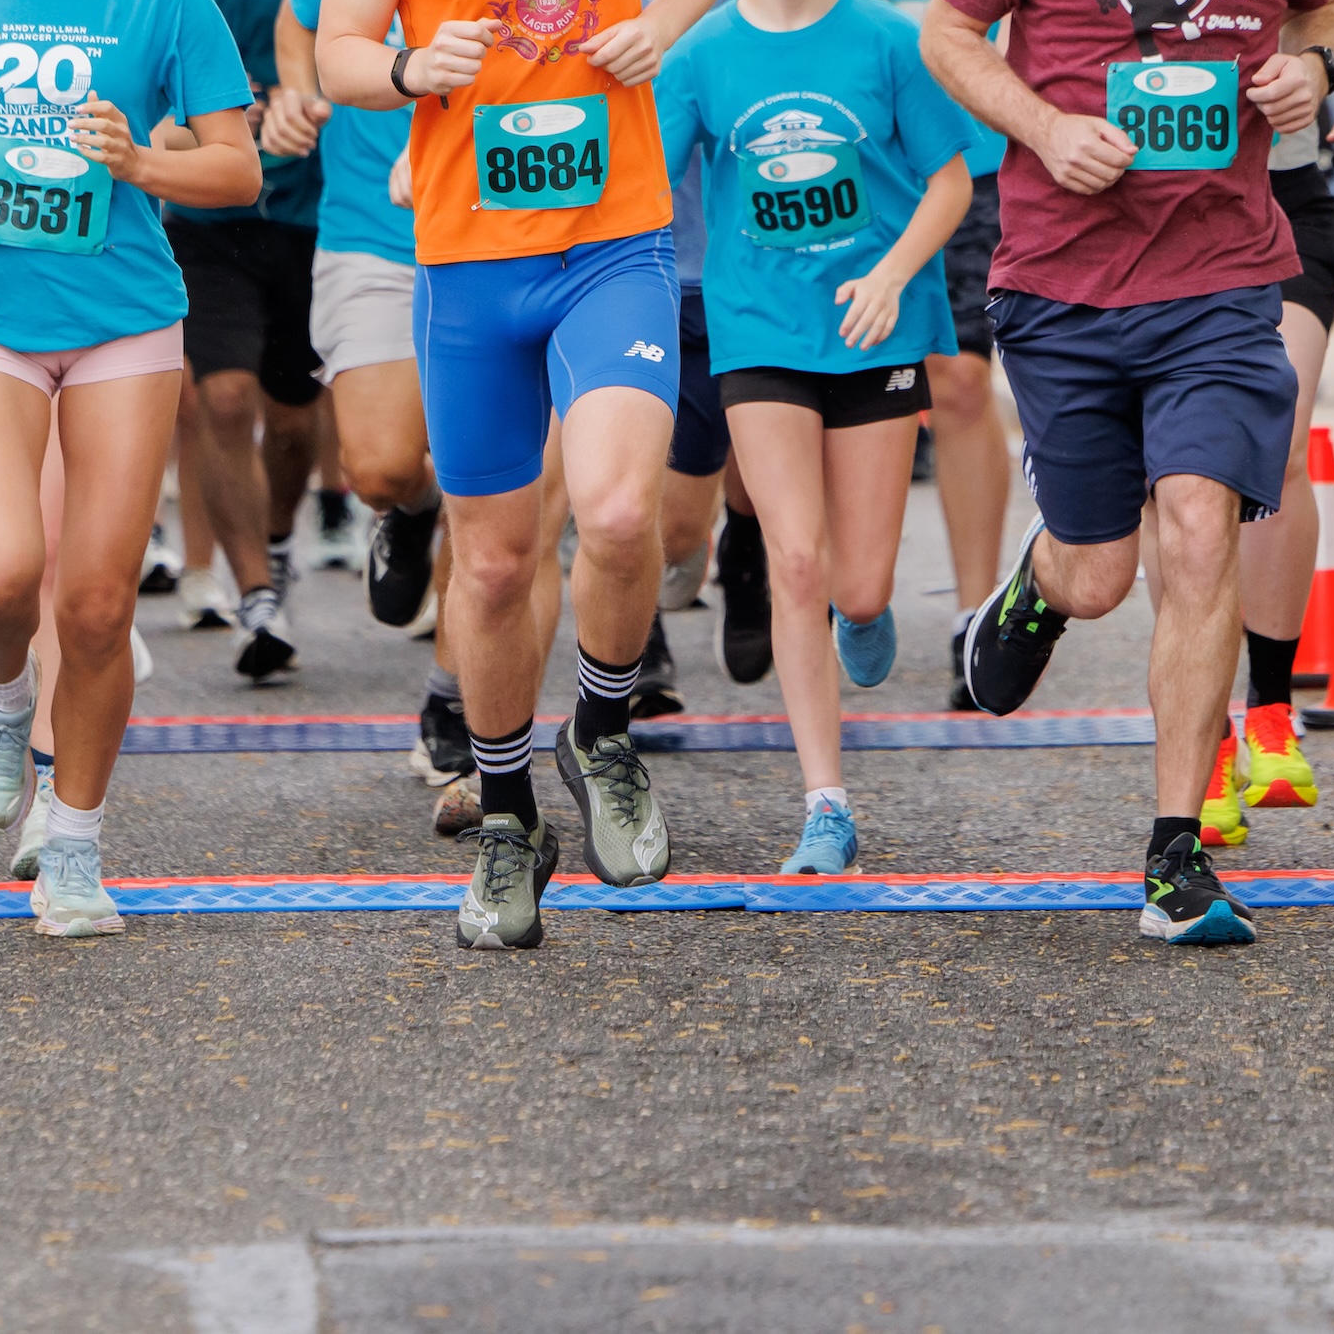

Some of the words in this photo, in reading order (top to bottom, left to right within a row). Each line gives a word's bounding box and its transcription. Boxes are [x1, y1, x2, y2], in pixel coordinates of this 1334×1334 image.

[2, 24, 36, 33] SANDY
[39, 25, 87, 34] ROLLMAN
[522, 14, 554, 32] LAGER
[556, 9, 575, 29] RUN
[1197, 16, 1204, 27] 1
[11, 33, 52, 42] CANCER
[55, 34, 118, 45] FOUNDATION
[1118, 104, 1229, 153] 8669
[486, 138, 603, 193] 8684
[752, 178, 858, 232] 8590
